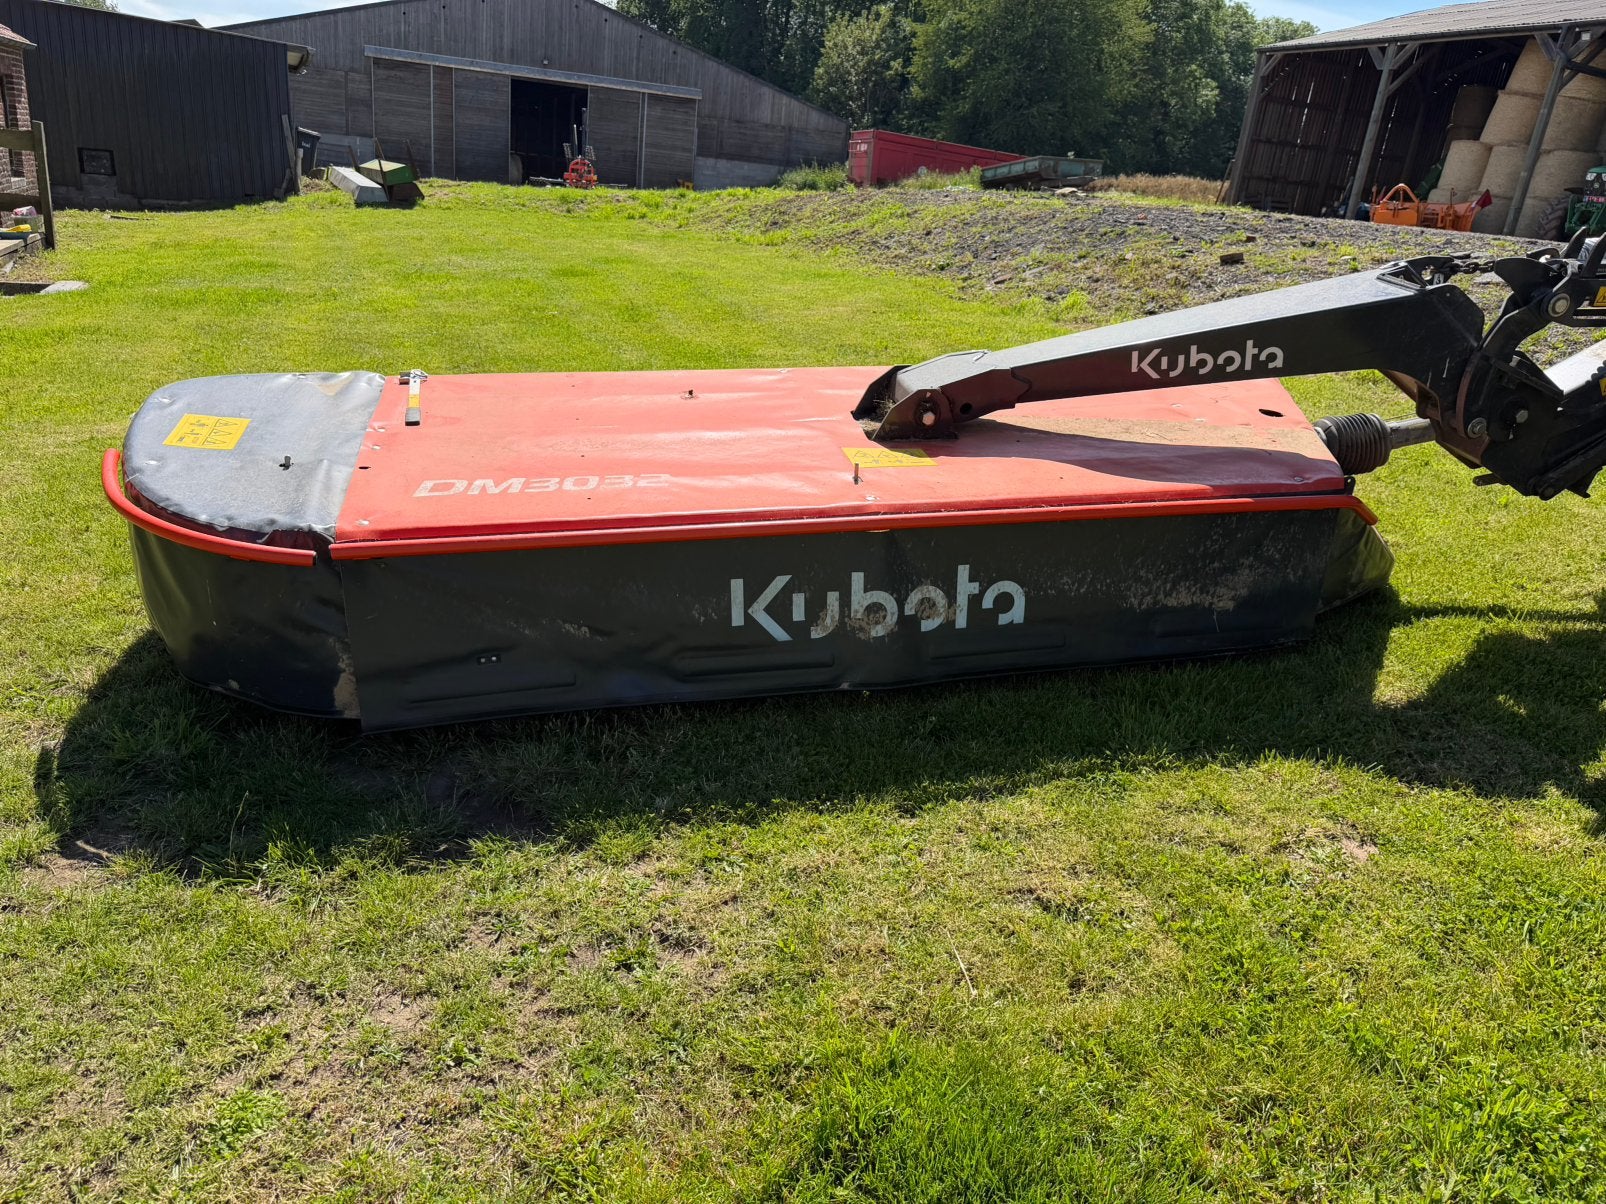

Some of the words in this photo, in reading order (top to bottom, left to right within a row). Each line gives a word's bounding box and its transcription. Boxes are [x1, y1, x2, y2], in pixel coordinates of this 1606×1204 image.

[1131, 340, 1284, 379] Kubota
[412, 473, 672, 498] DM3032
[730, 564, 1026, 642] Kubota
